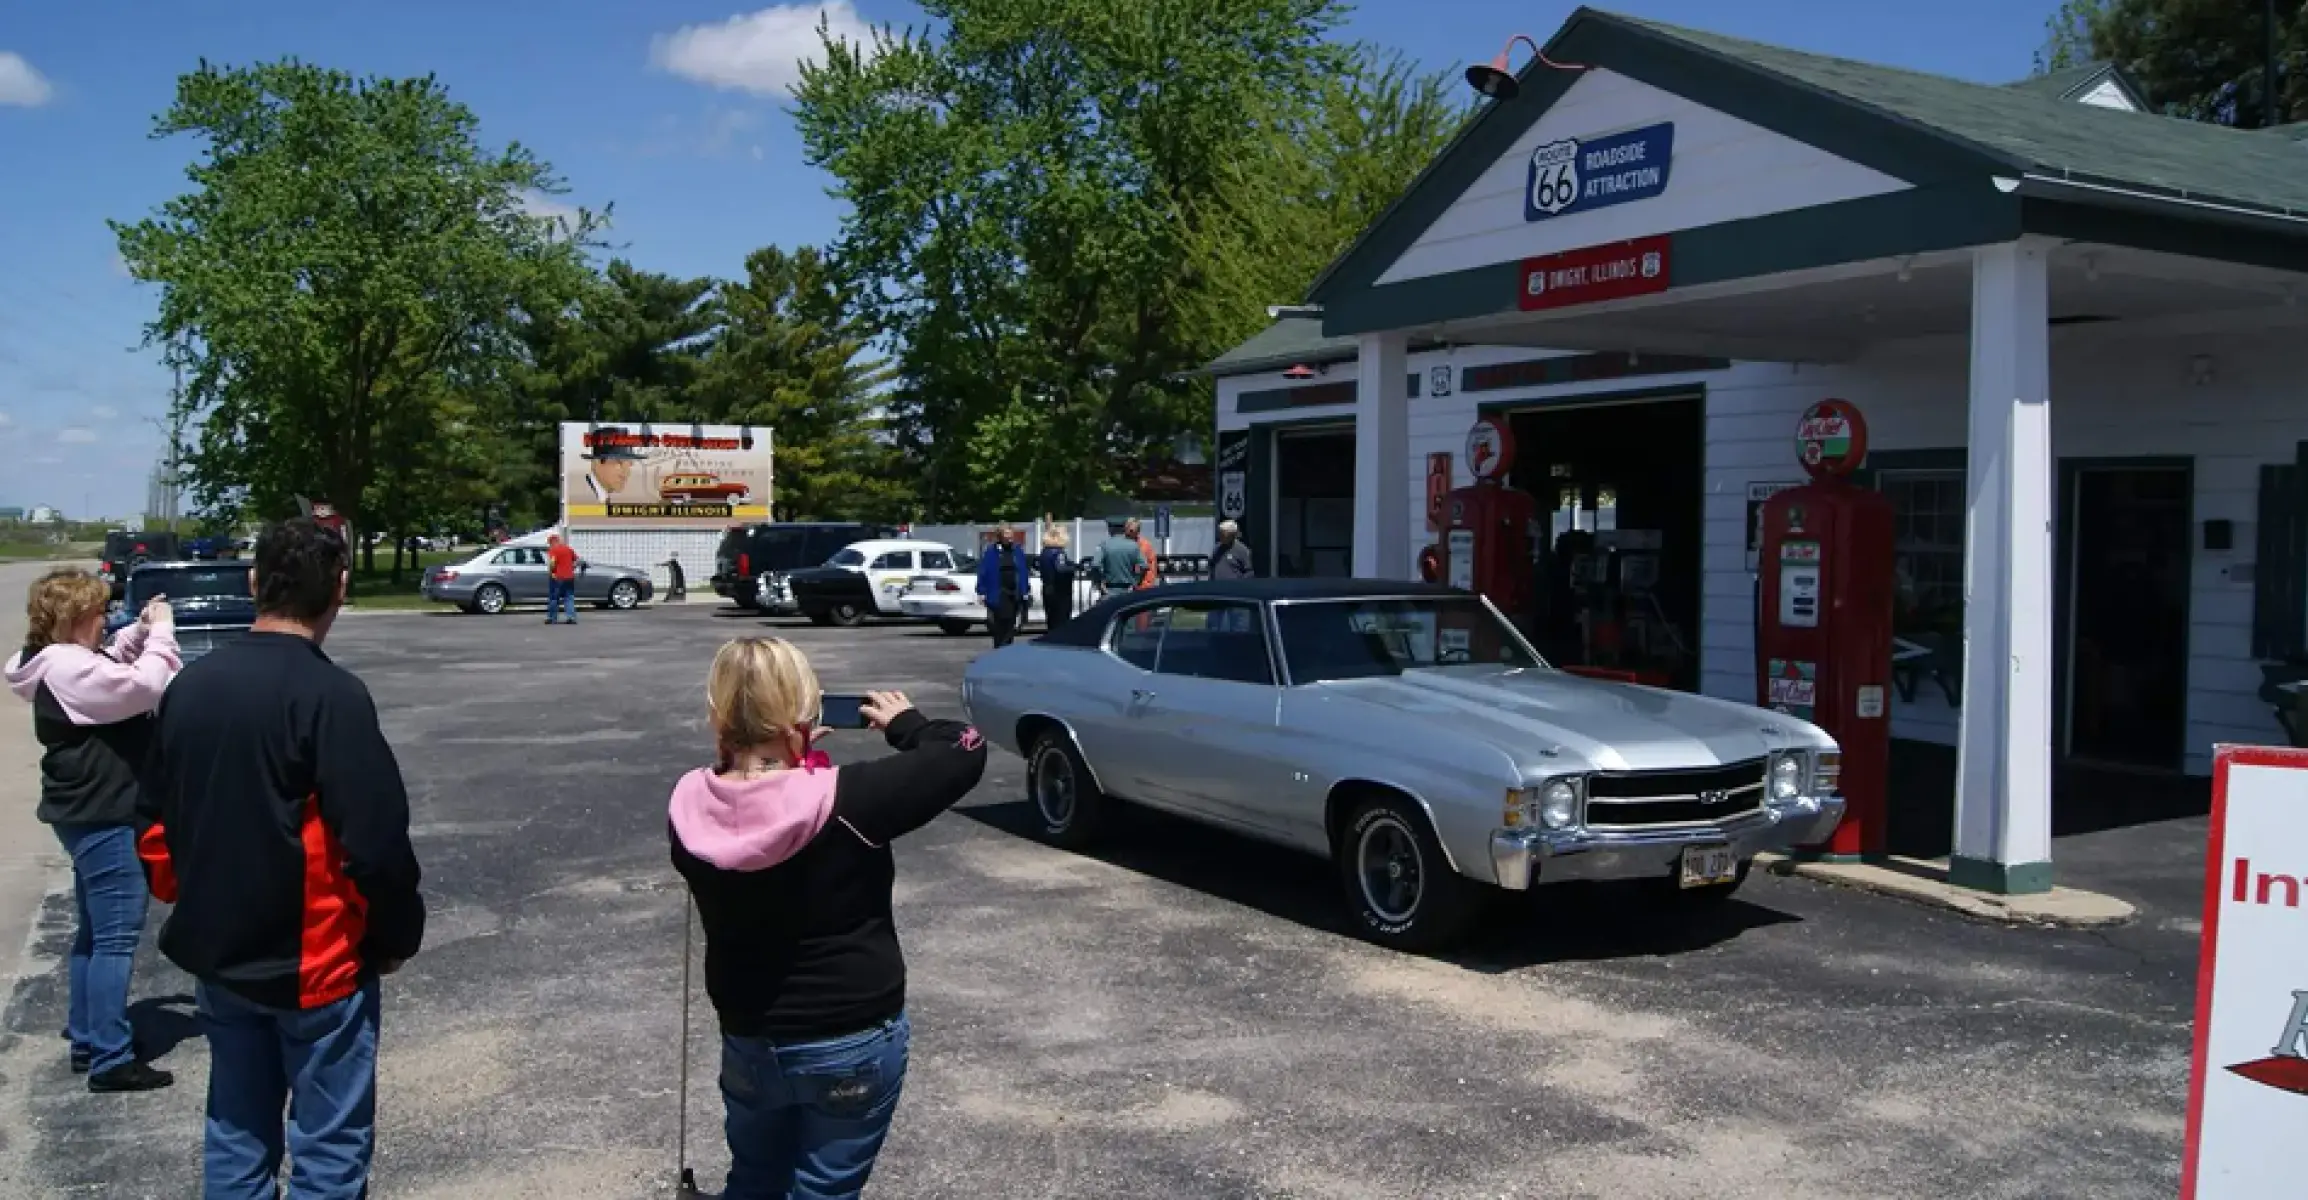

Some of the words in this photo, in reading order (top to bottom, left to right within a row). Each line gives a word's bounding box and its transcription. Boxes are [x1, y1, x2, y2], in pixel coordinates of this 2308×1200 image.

[1585, 140, 1647, 171] ROADSIDE
[1537, 164, 1573, 207] 66
[1583, 166, 1661, 199] ATTRACTION
[1591, 256, 1637, 284] ILLINOIS
[611, 506, 665, 517] DWIGHT
[669, 506, 728, 517] ILLINOIS
[1226, 491, 1243, 511] 66
[2231, 857, 2308, 907] In
